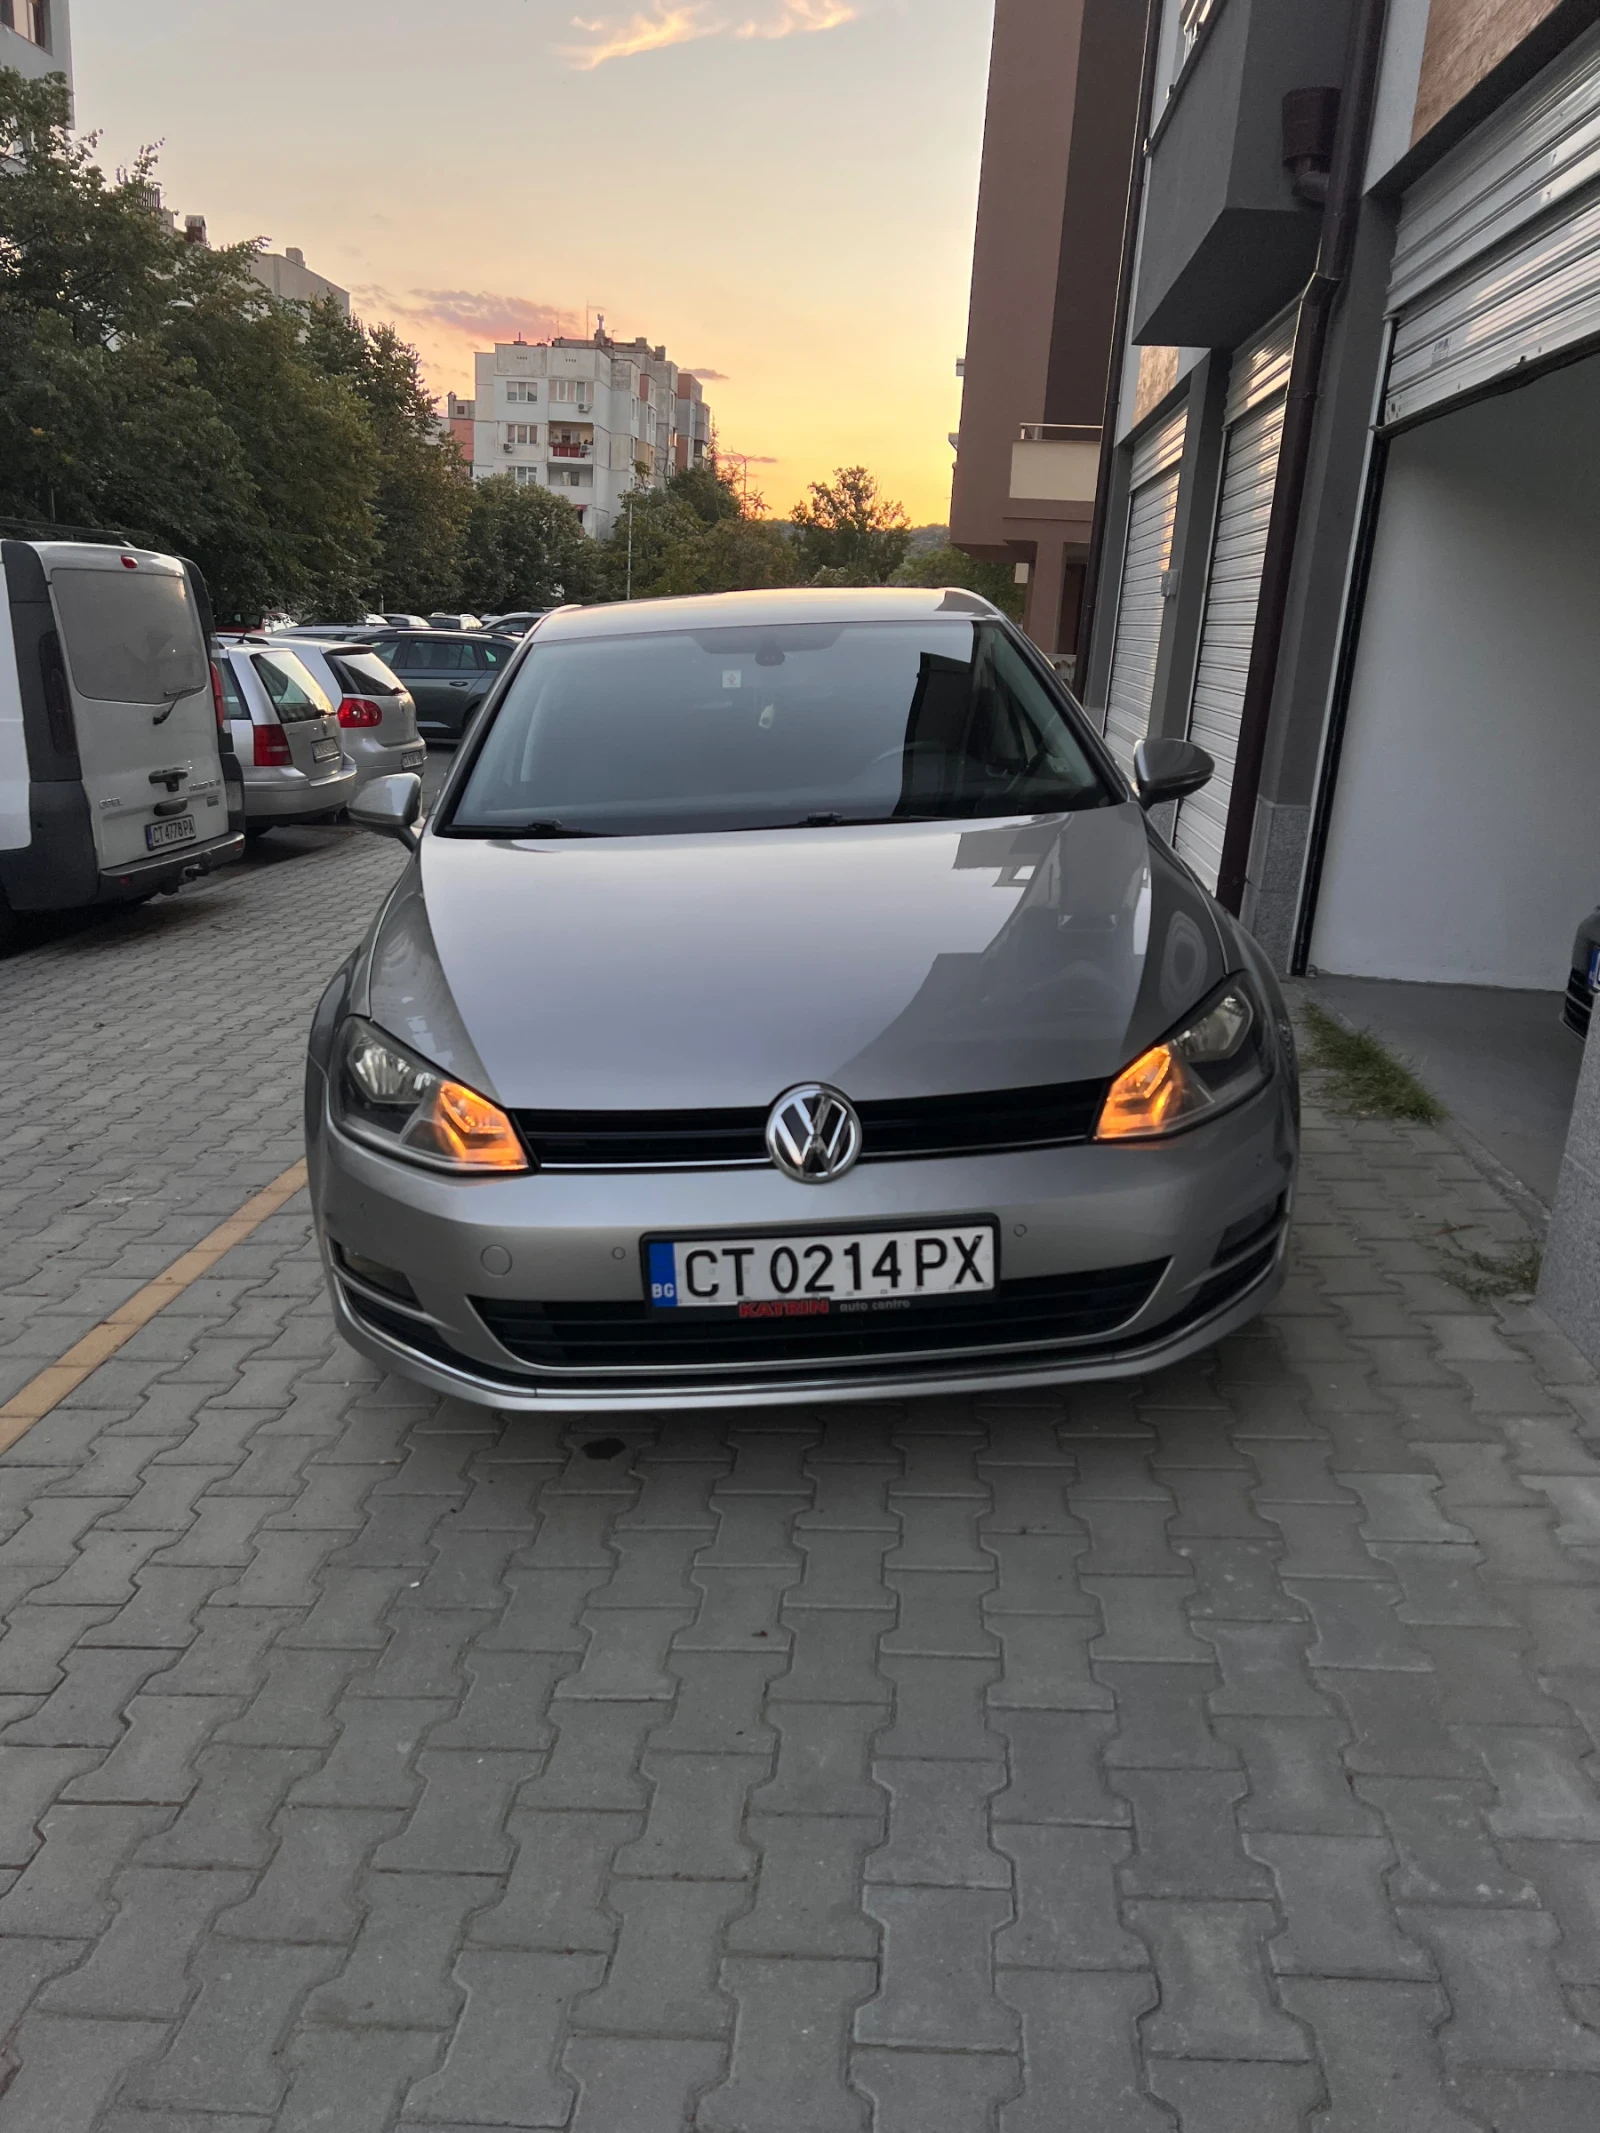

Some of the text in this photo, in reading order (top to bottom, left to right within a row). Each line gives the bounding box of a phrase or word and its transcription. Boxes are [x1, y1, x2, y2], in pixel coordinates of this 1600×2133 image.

[685, 1234, 983, 1297] CT 0214 PX
[651, 1283, 674, 1298] BG
[739, 1299, 829, 1317] KATRIN
[839, 1301, 869, 1312] auto
